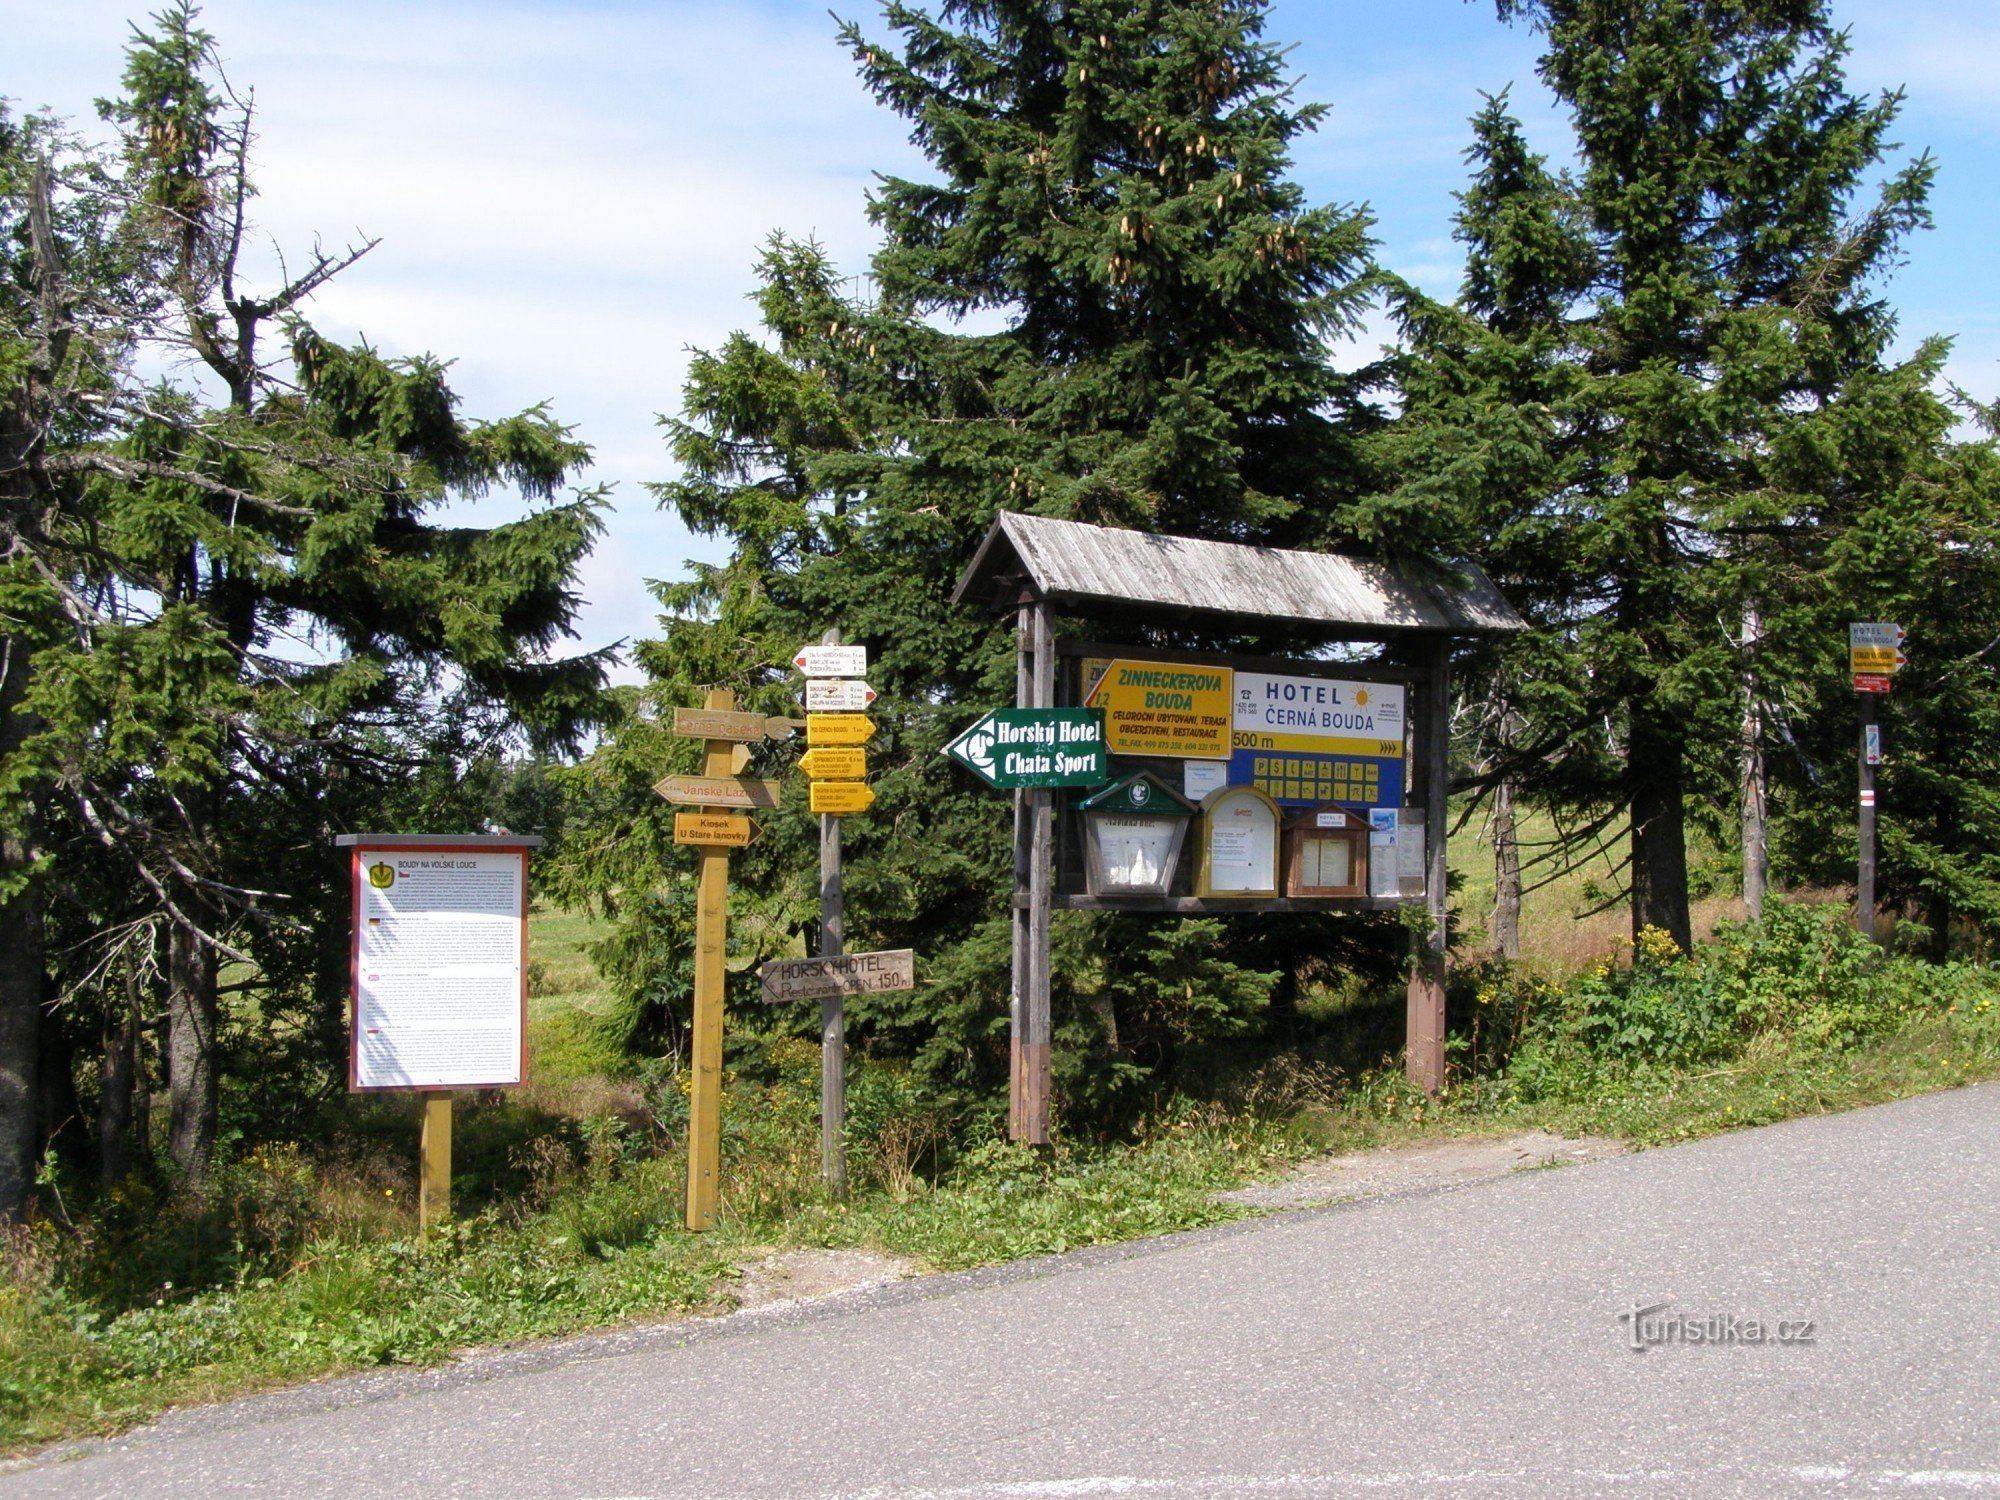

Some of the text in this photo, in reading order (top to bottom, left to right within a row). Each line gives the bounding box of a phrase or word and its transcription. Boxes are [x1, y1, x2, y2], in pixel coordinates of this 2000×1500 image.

[1118, 669, 1222, 692] ZINNECKEROVA
[1145, 691, 1193, 711] BOUDA
[1266, 682, 1342, 705] HOTEL
[1200, 715, 1227, 727] TERASA
[1265, 703, 1317, 727] ČERNÁ
[1322, 712, 1374, 731] BOUDA
[997, 721, 1101, 746] Horský Hotel
[1173, 727, 1219, 739] RESTAURACE
[1232, 732, 1274, 749] 500 m
[1005, 752, 1096, 776] Chata Sport
[700, 819, 730, 829] Kiosek
[681, 830, 687, 838] U
[398, 860, 419, 869] BOUDY
[421, 861, 430, 869] NA
[456, 861, 477, 869] LOUCE
[878, 972, 900, 989] 150
